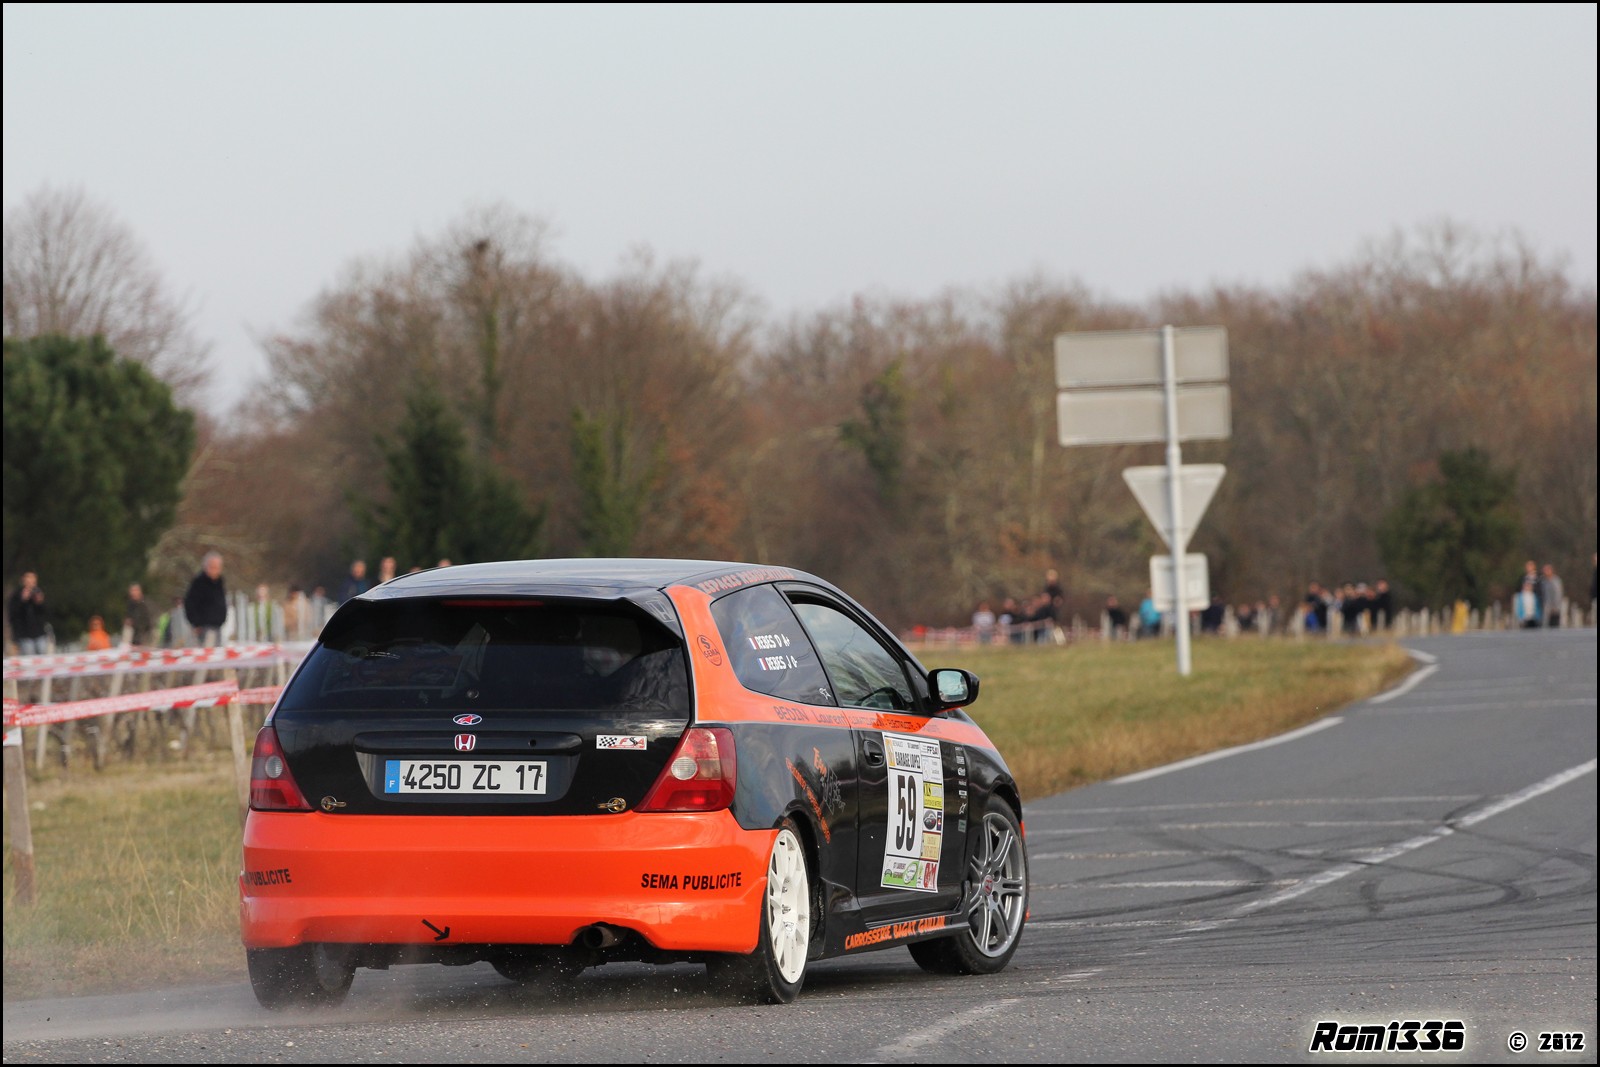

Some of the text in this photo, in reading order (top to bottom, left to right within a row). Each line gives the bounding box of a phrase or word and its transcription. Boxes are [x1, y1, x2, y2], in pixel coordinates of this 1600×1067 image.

[754, 634, 776, 650] REBES
[703, 648, 721, 659] SEMA
[765, 655, 786, 671] REBES
[773, 706, 809, 722] BEDIN
[389, 780, 395, 788] F
[404, 764, 542, 790] 4250 ZC 17
[896, 774, 917, 852] 59
[641, 872, 742, 890] SEMA PUBLICITE
[845, 925, 893, 951] CARROSSERIE
